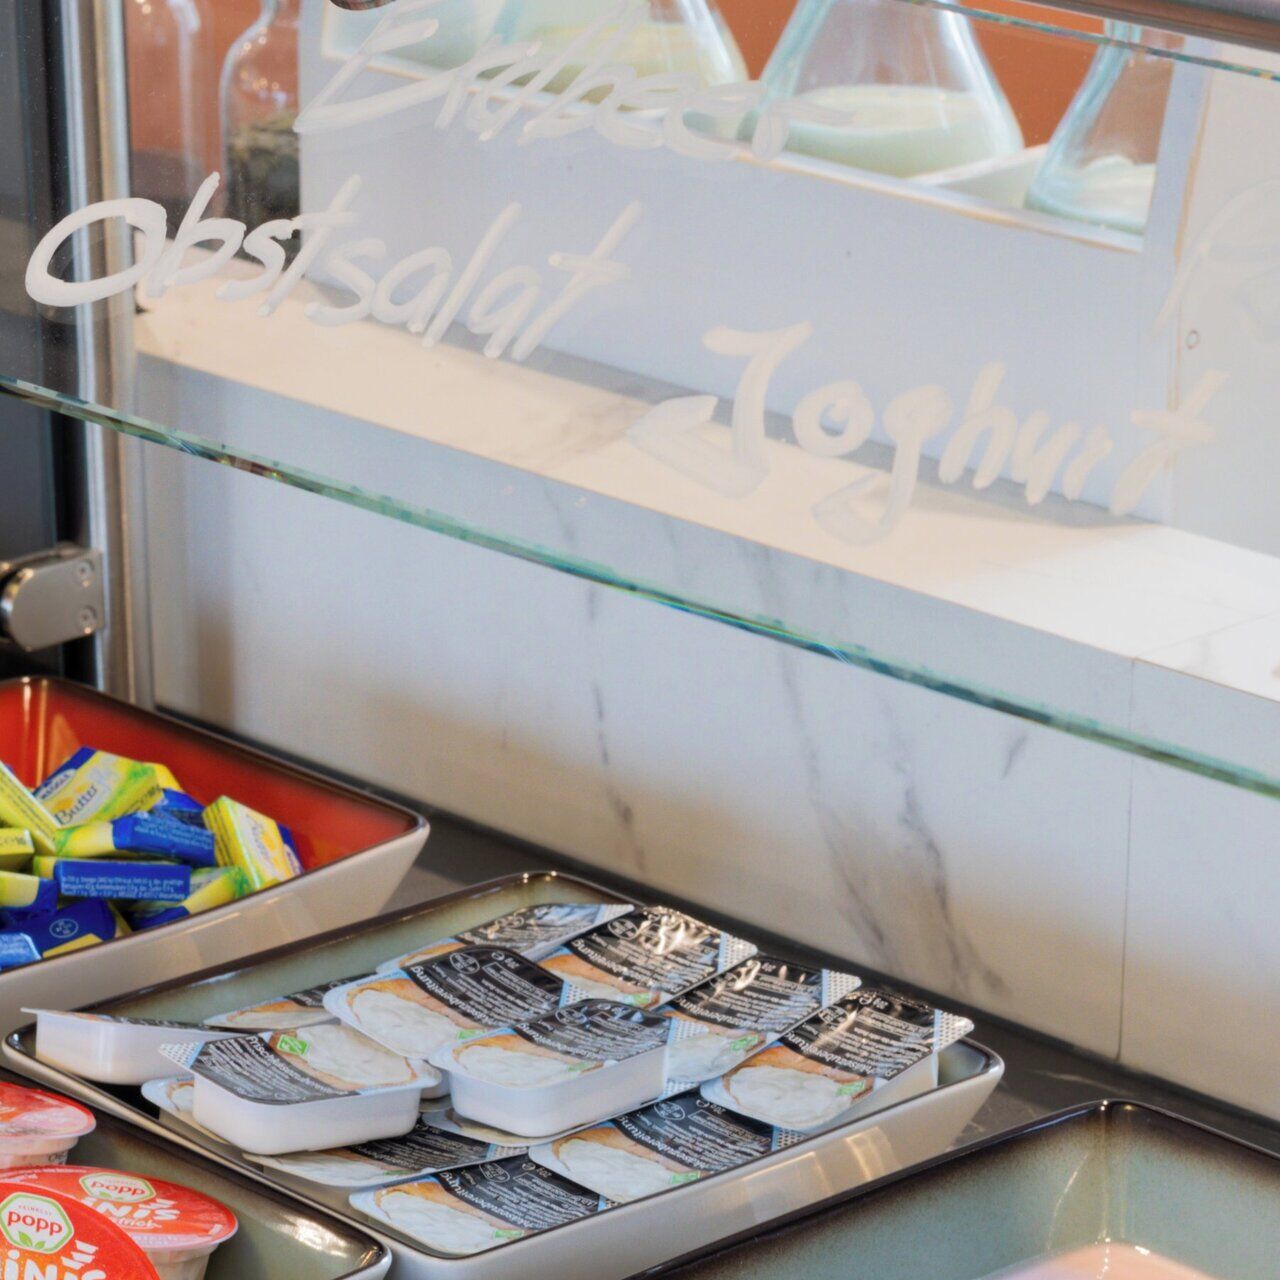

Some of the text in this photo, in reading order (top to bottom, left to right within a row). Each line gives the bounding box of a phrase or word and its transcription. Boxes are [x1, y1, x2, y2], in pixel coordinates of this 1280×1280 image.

[25, 172, 642, 360] Obstsalat
[623, 320, 1232, 546] Joghurt
[53, 784, 98, 826] Butter
[91, 1179, 147, 1197] popp
[7, 1210, 64, 1237] popp
